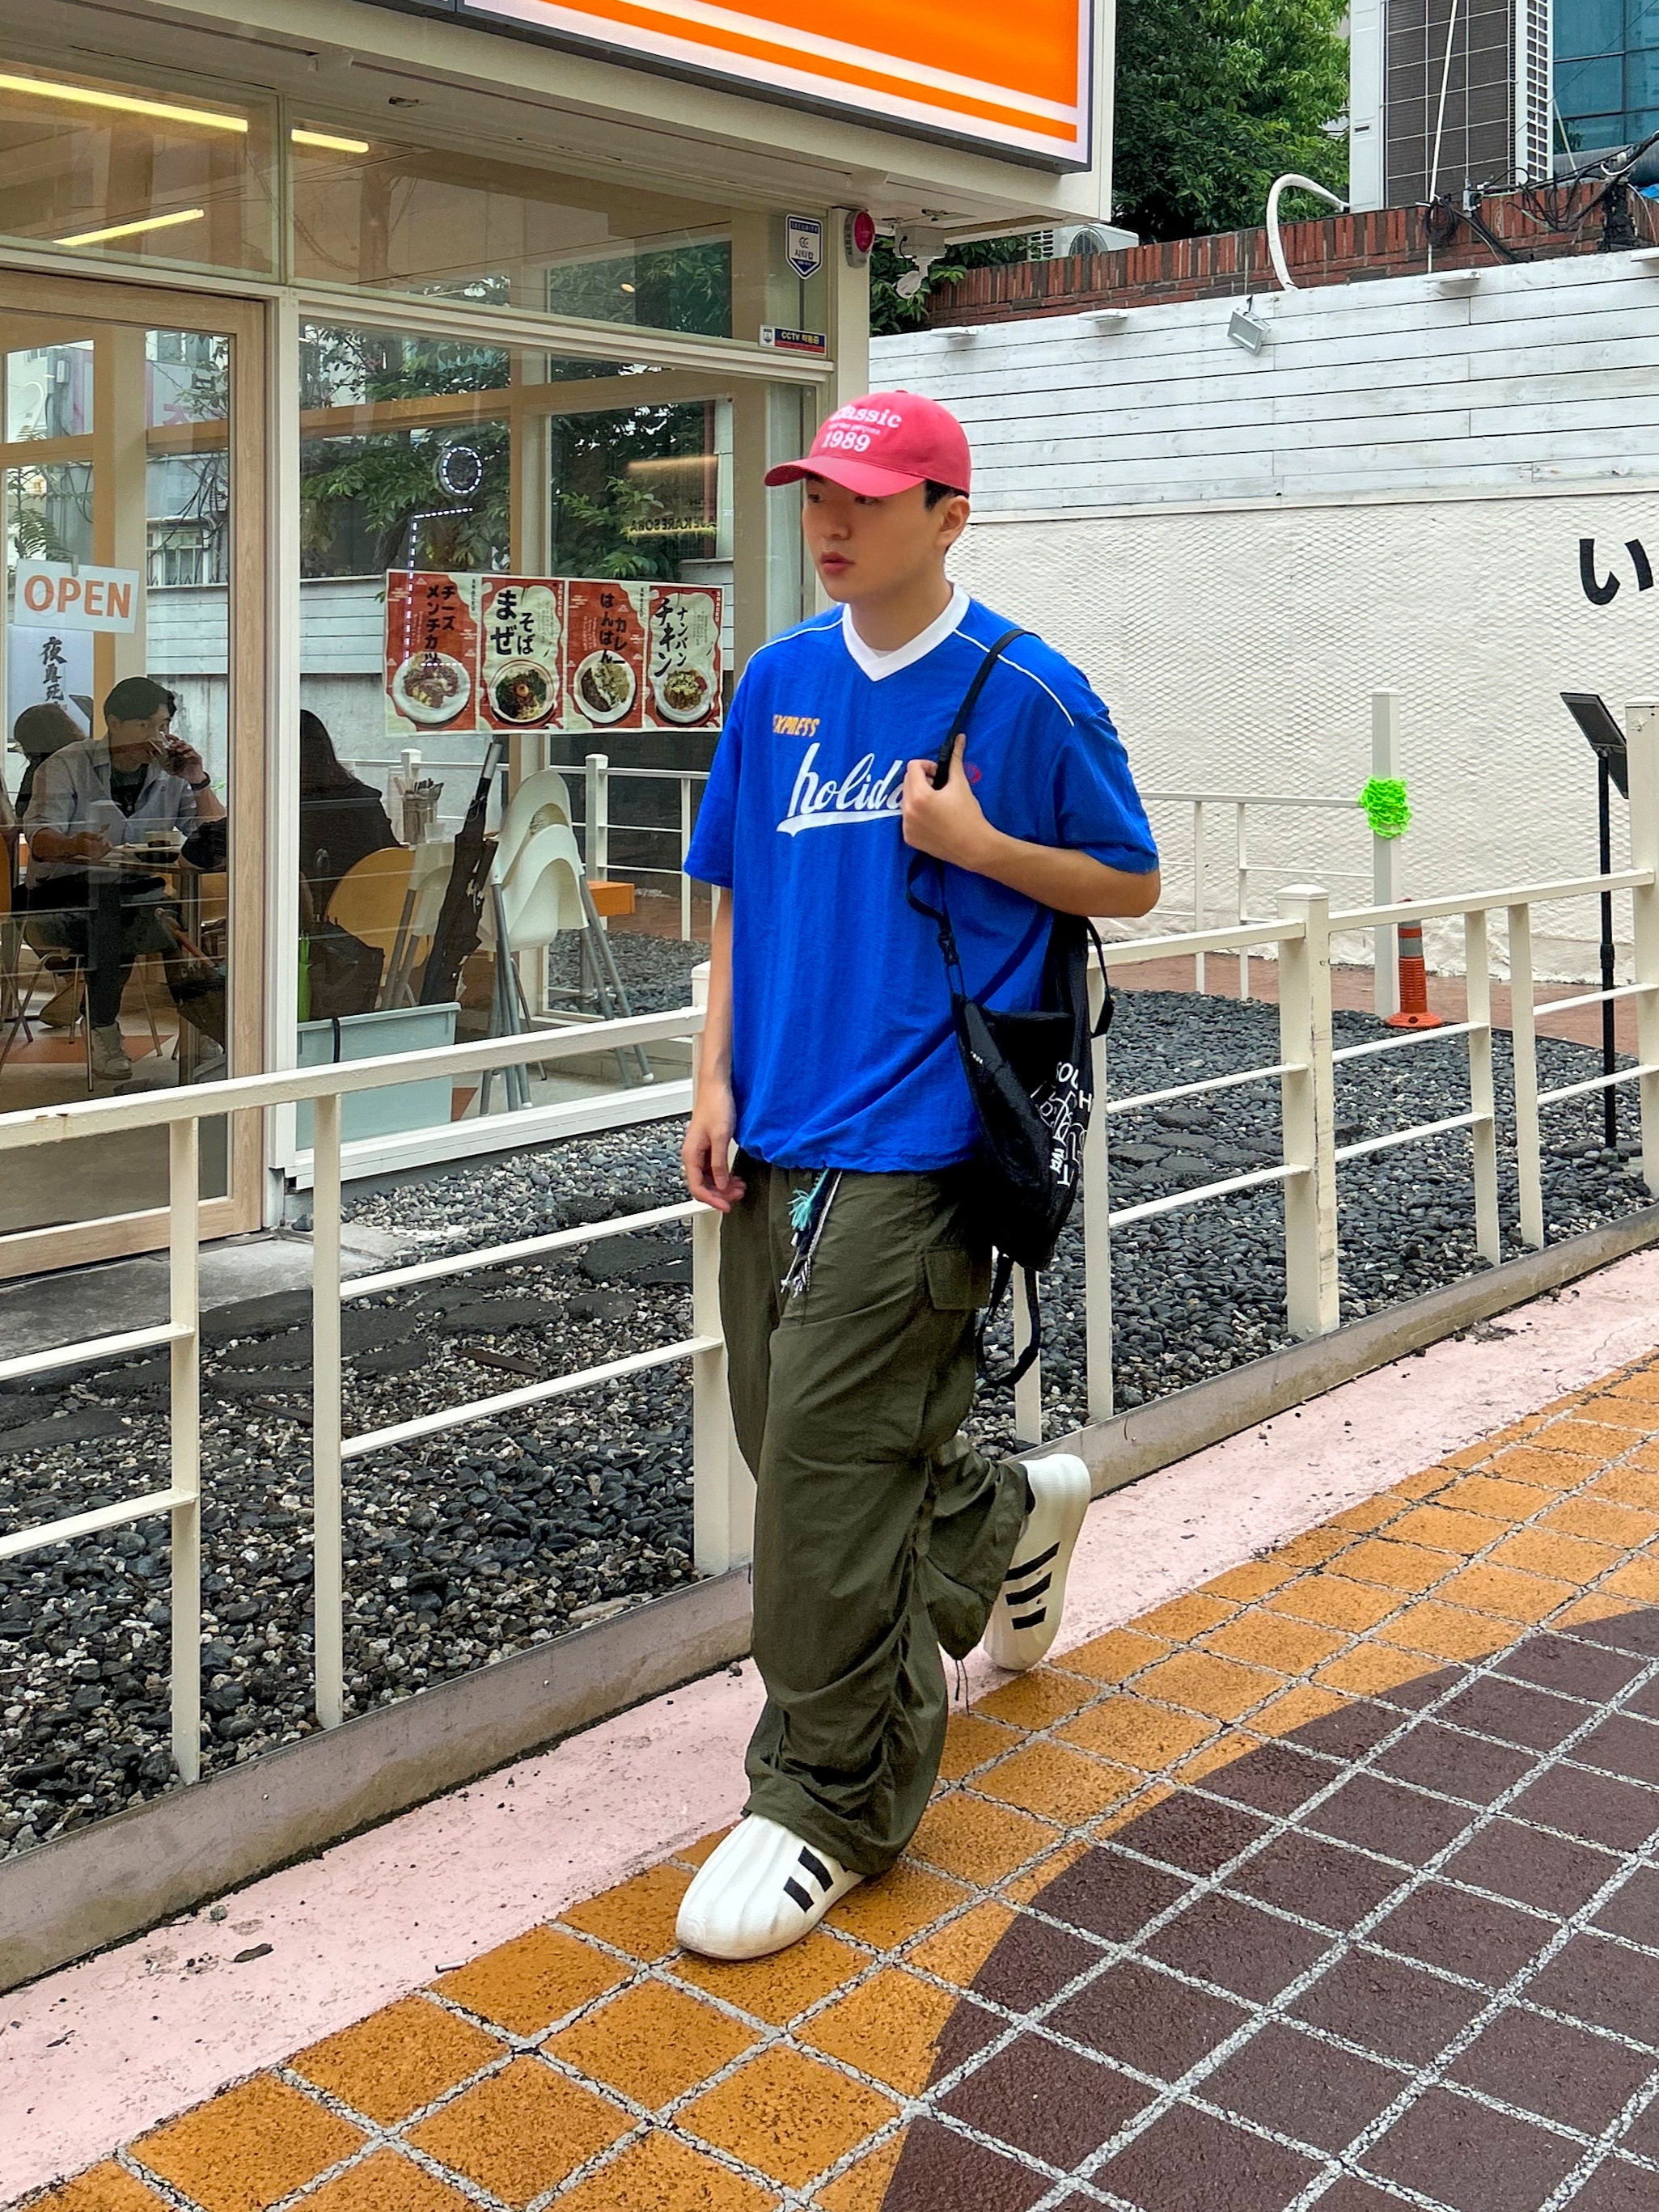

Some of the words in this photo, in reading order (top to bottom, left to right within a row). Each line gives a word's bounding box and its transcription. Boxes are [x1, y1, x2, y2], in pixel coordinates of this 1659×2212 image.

[791, 221, 819, 232] SECURITY
[781, 331, 801, 340] CCTV
[821, 431, 871, 452] 1989
[1579, 539, 1654, 606] い
[23, 574, 131, 619] OPEN
[442, 585, 456, 631] チーズ
[425, 584, 441, 664] メンチカツ
[490, 590, 518, 656] まぜ
[517, 612, 535, 655] そば
[613, 617, 628, 664] カレー
[654, 597, 675, 678] チキン
[675, 607, 688, 667] ナンバン
[787, 742, 904, 818] holid
